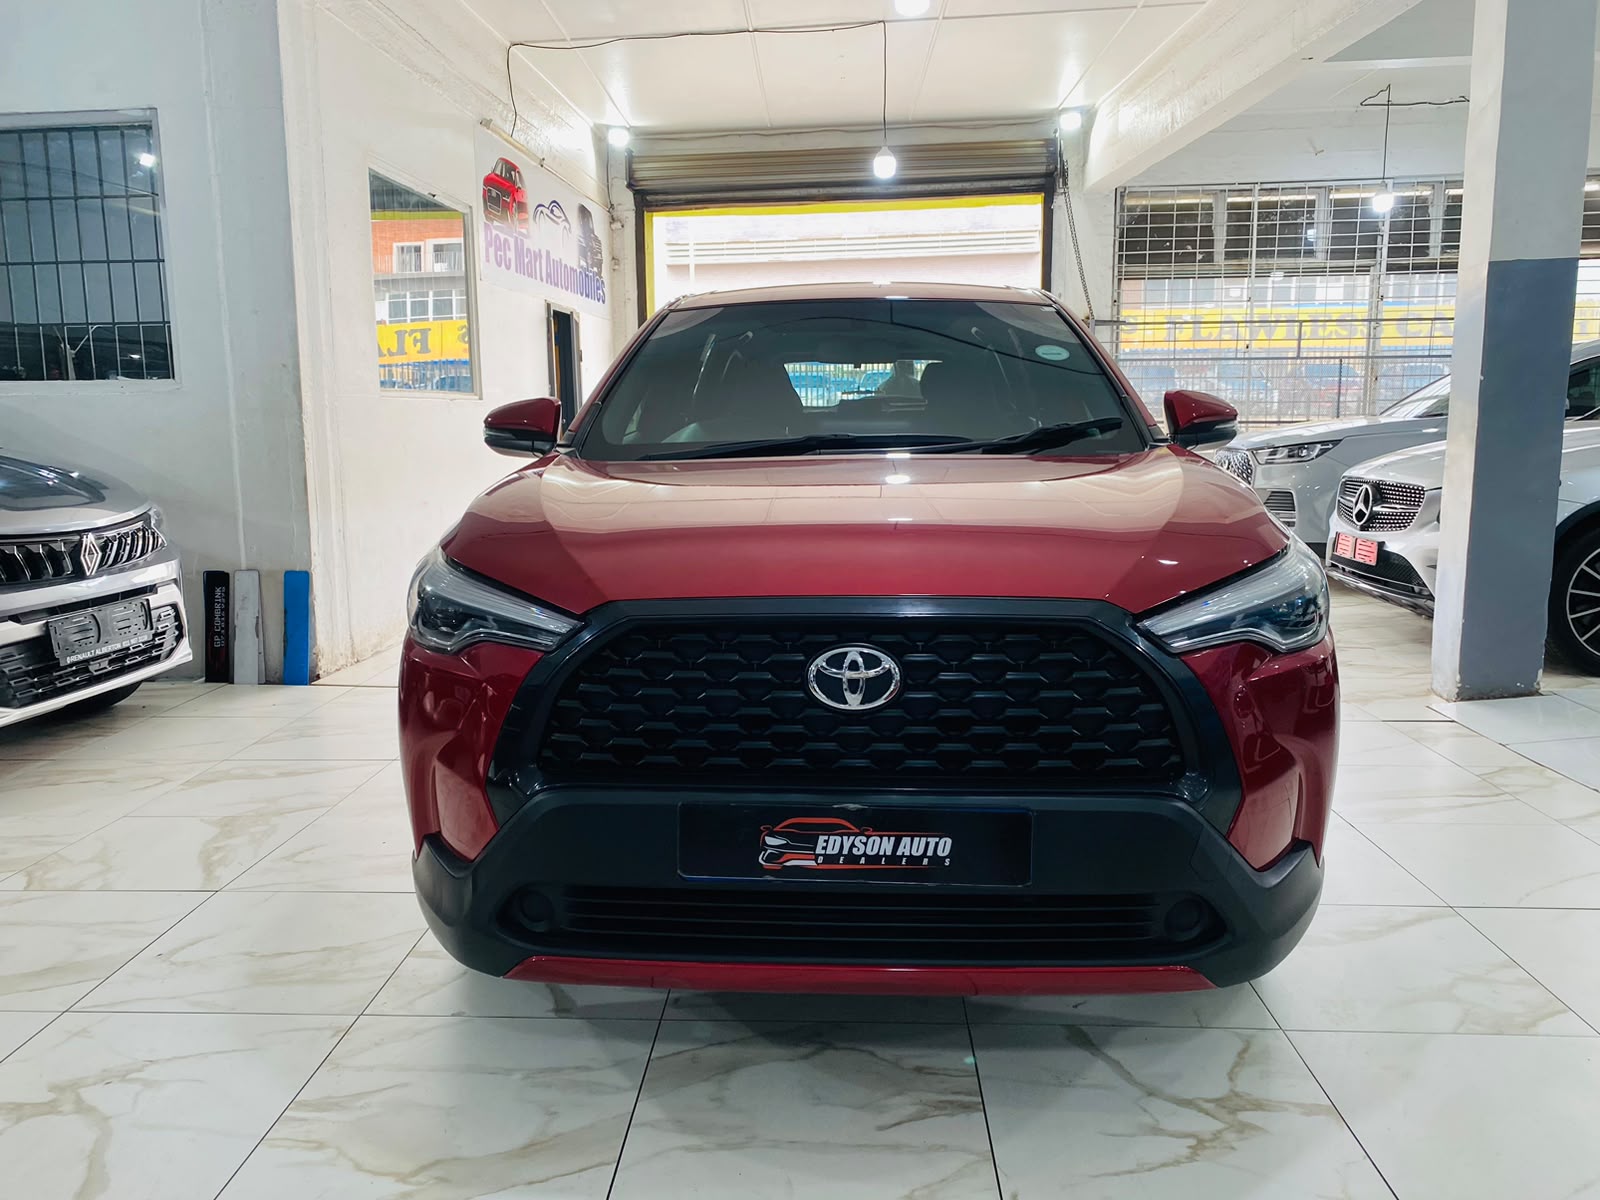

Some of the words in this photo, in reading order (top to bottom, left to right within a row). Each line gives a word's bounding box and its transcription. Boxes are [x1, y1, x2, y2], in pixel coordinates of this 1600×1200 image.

[484, 221, 512, 271] Pec
[514, 235, 544, 282] Mart
[545, 249, 606, 304] Automobiles
[70, 649, 95, 663] RENAULT
[815, 835, 896, 856] EDYSON
[896, 836, 953, 857] AUTO
[817, 856, 951, 866] DEALERS
